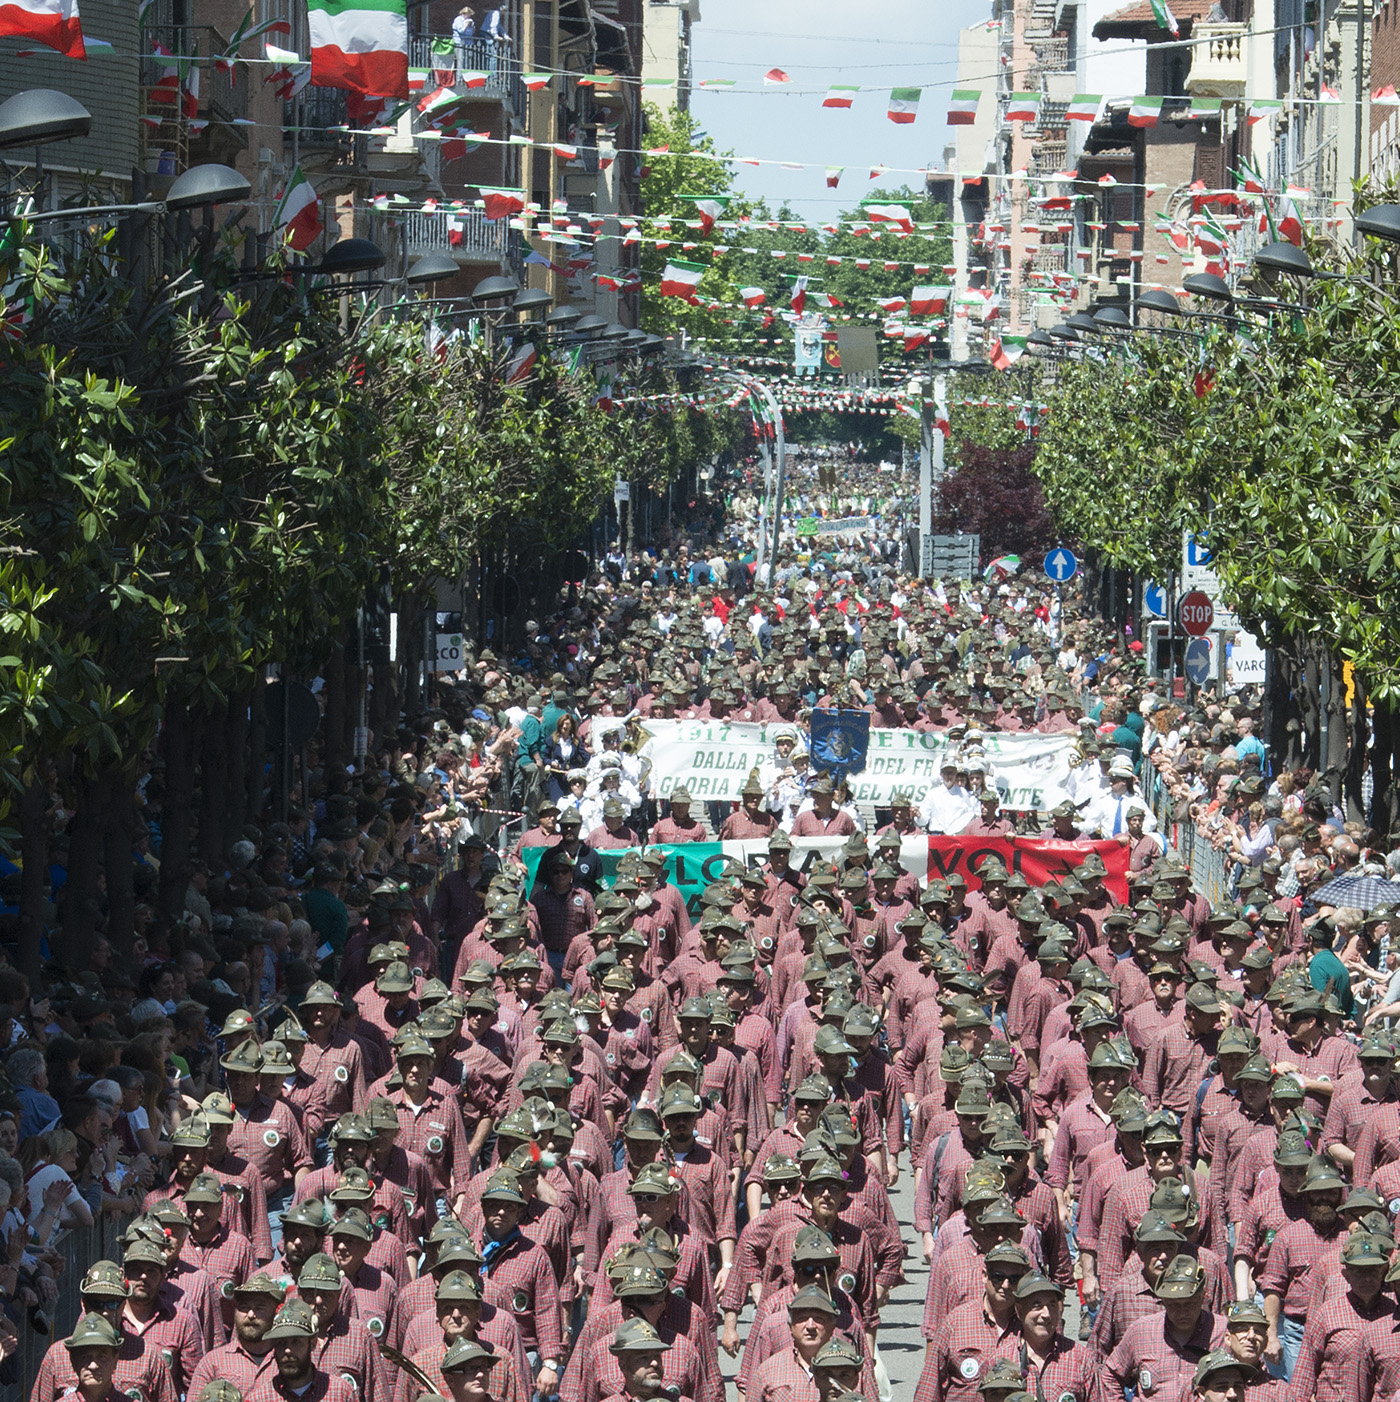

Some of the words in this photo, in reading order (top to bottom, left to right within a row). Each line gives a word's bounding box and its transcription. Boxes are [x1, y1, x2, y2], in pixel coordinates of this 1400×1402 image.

[1182, 605, 1212, 623] STOP
[1236, 659, 1265, 672] VARC
[692, 751, 748, 770] DALLA
[872, 758, 905, 775] DEL
